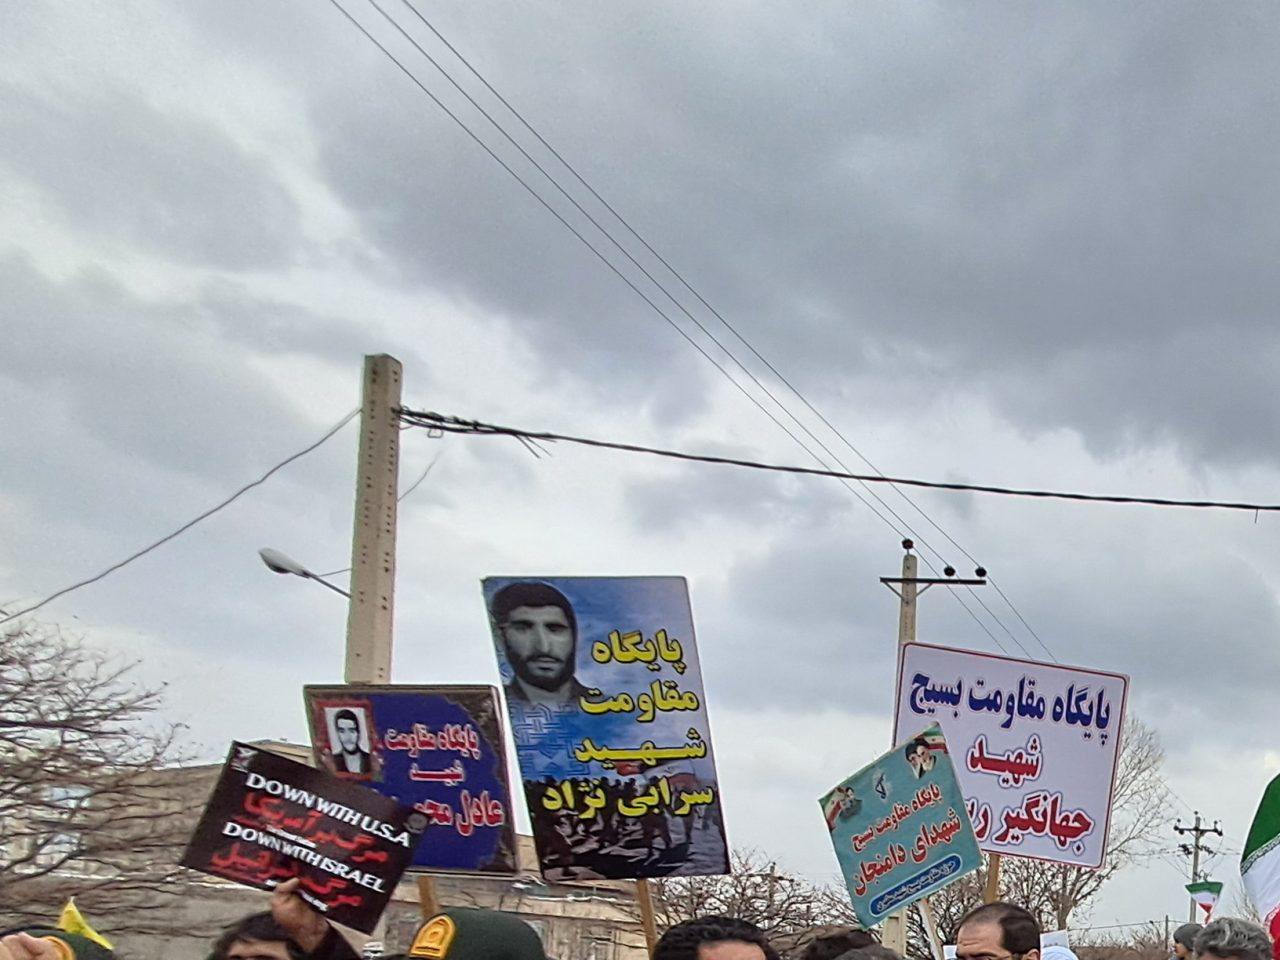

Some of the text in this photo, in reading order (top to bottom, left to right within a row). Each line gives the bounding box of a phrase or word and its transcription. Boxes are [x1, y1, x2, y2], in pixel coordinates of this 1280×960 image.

[591, 629, 687, 675] پایگاه
[579, 678, 699, 722] مقاومت
[910, 673, 1110, 746] پایگاه مقاومت بسیج
[385, 723, 480, 760] پایگاه مقاومت
[575, 727, 707, 769] شهید
[966, 733, 1043, 786] شهید
[245, 772, 314, 808] DOWN
[315, 796, 361, 829] WITH
[456, 790, 504, 836] عادل
[542, 776, 714, 820] سرابی نژاد
[852, 784, 942, 851] پایگاه مقاومت بسیج
[995, 794, 1093, 853] جهانگیر
[221, 821, 281, 852] DOWN
[280, 841, 322, 867] WITH
[319, 857, 387, 893] ISRAEL
[911, 809, 961, 863] شهدای
